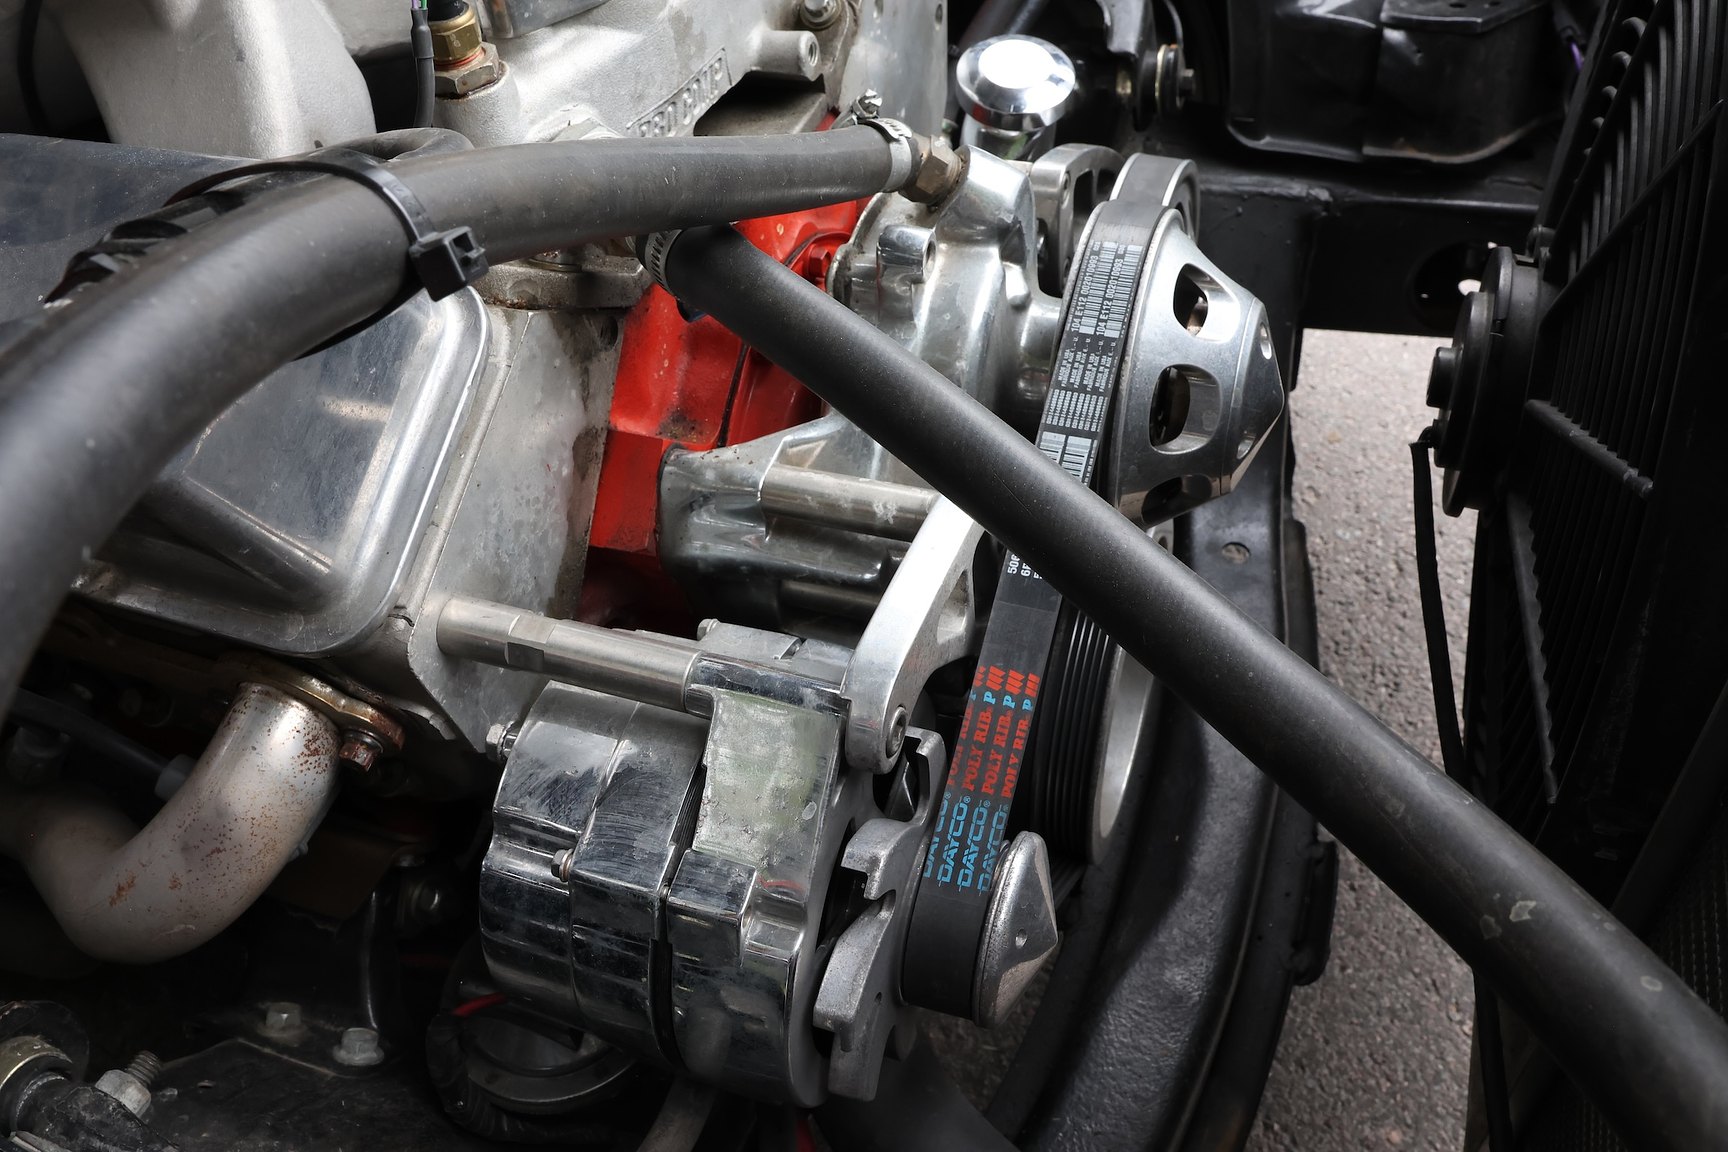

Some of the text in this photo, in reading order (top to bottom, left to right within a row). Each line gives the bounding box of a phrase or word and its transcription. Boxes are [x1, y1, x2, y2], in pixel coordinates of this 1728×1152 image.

[1081, 255, 1098, 294] 002010993
[1106, 259, 1123, 298] 002010993
[1076, 297, 1087, 315] E112
[1100, 301, 1112, 319] E112
[1072, 318, 1081, 331] 104
[1097, 322, 1107, 335] 104
[983, 690, 998, 705] P
[974, 710, 993, 744] RIB
[982, 749, 1003, 795] POLY
[993, 715, 1012, 748] RIB
[1003, 694, 1017, 709] P
[962, 744, 984, 792] POLY
